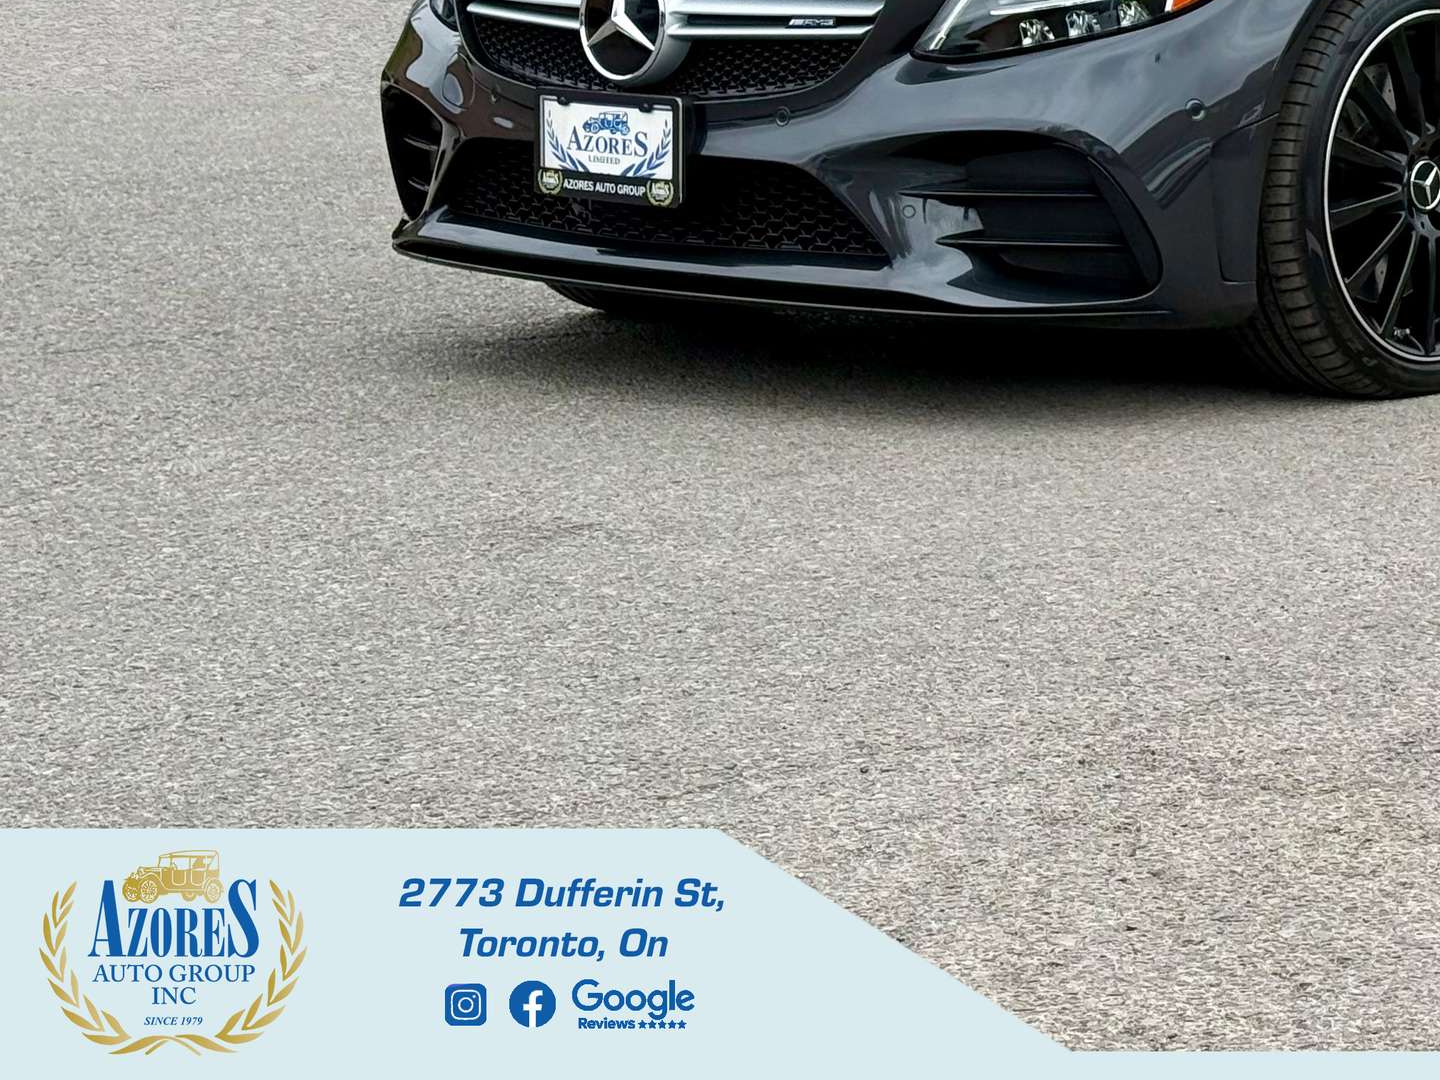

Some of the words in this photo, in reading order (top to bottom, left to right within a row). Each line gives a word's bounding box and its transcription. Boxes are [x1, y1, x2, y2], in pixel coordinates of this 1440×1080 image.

[567, 126, 649, 158] AZORES
[588, 154, 620, 165] LIMITED
[563, 178, 594, 191] AZORES
[595, 181, 616, 194] AUTO
[617, 184, 646, 197] GROUP
